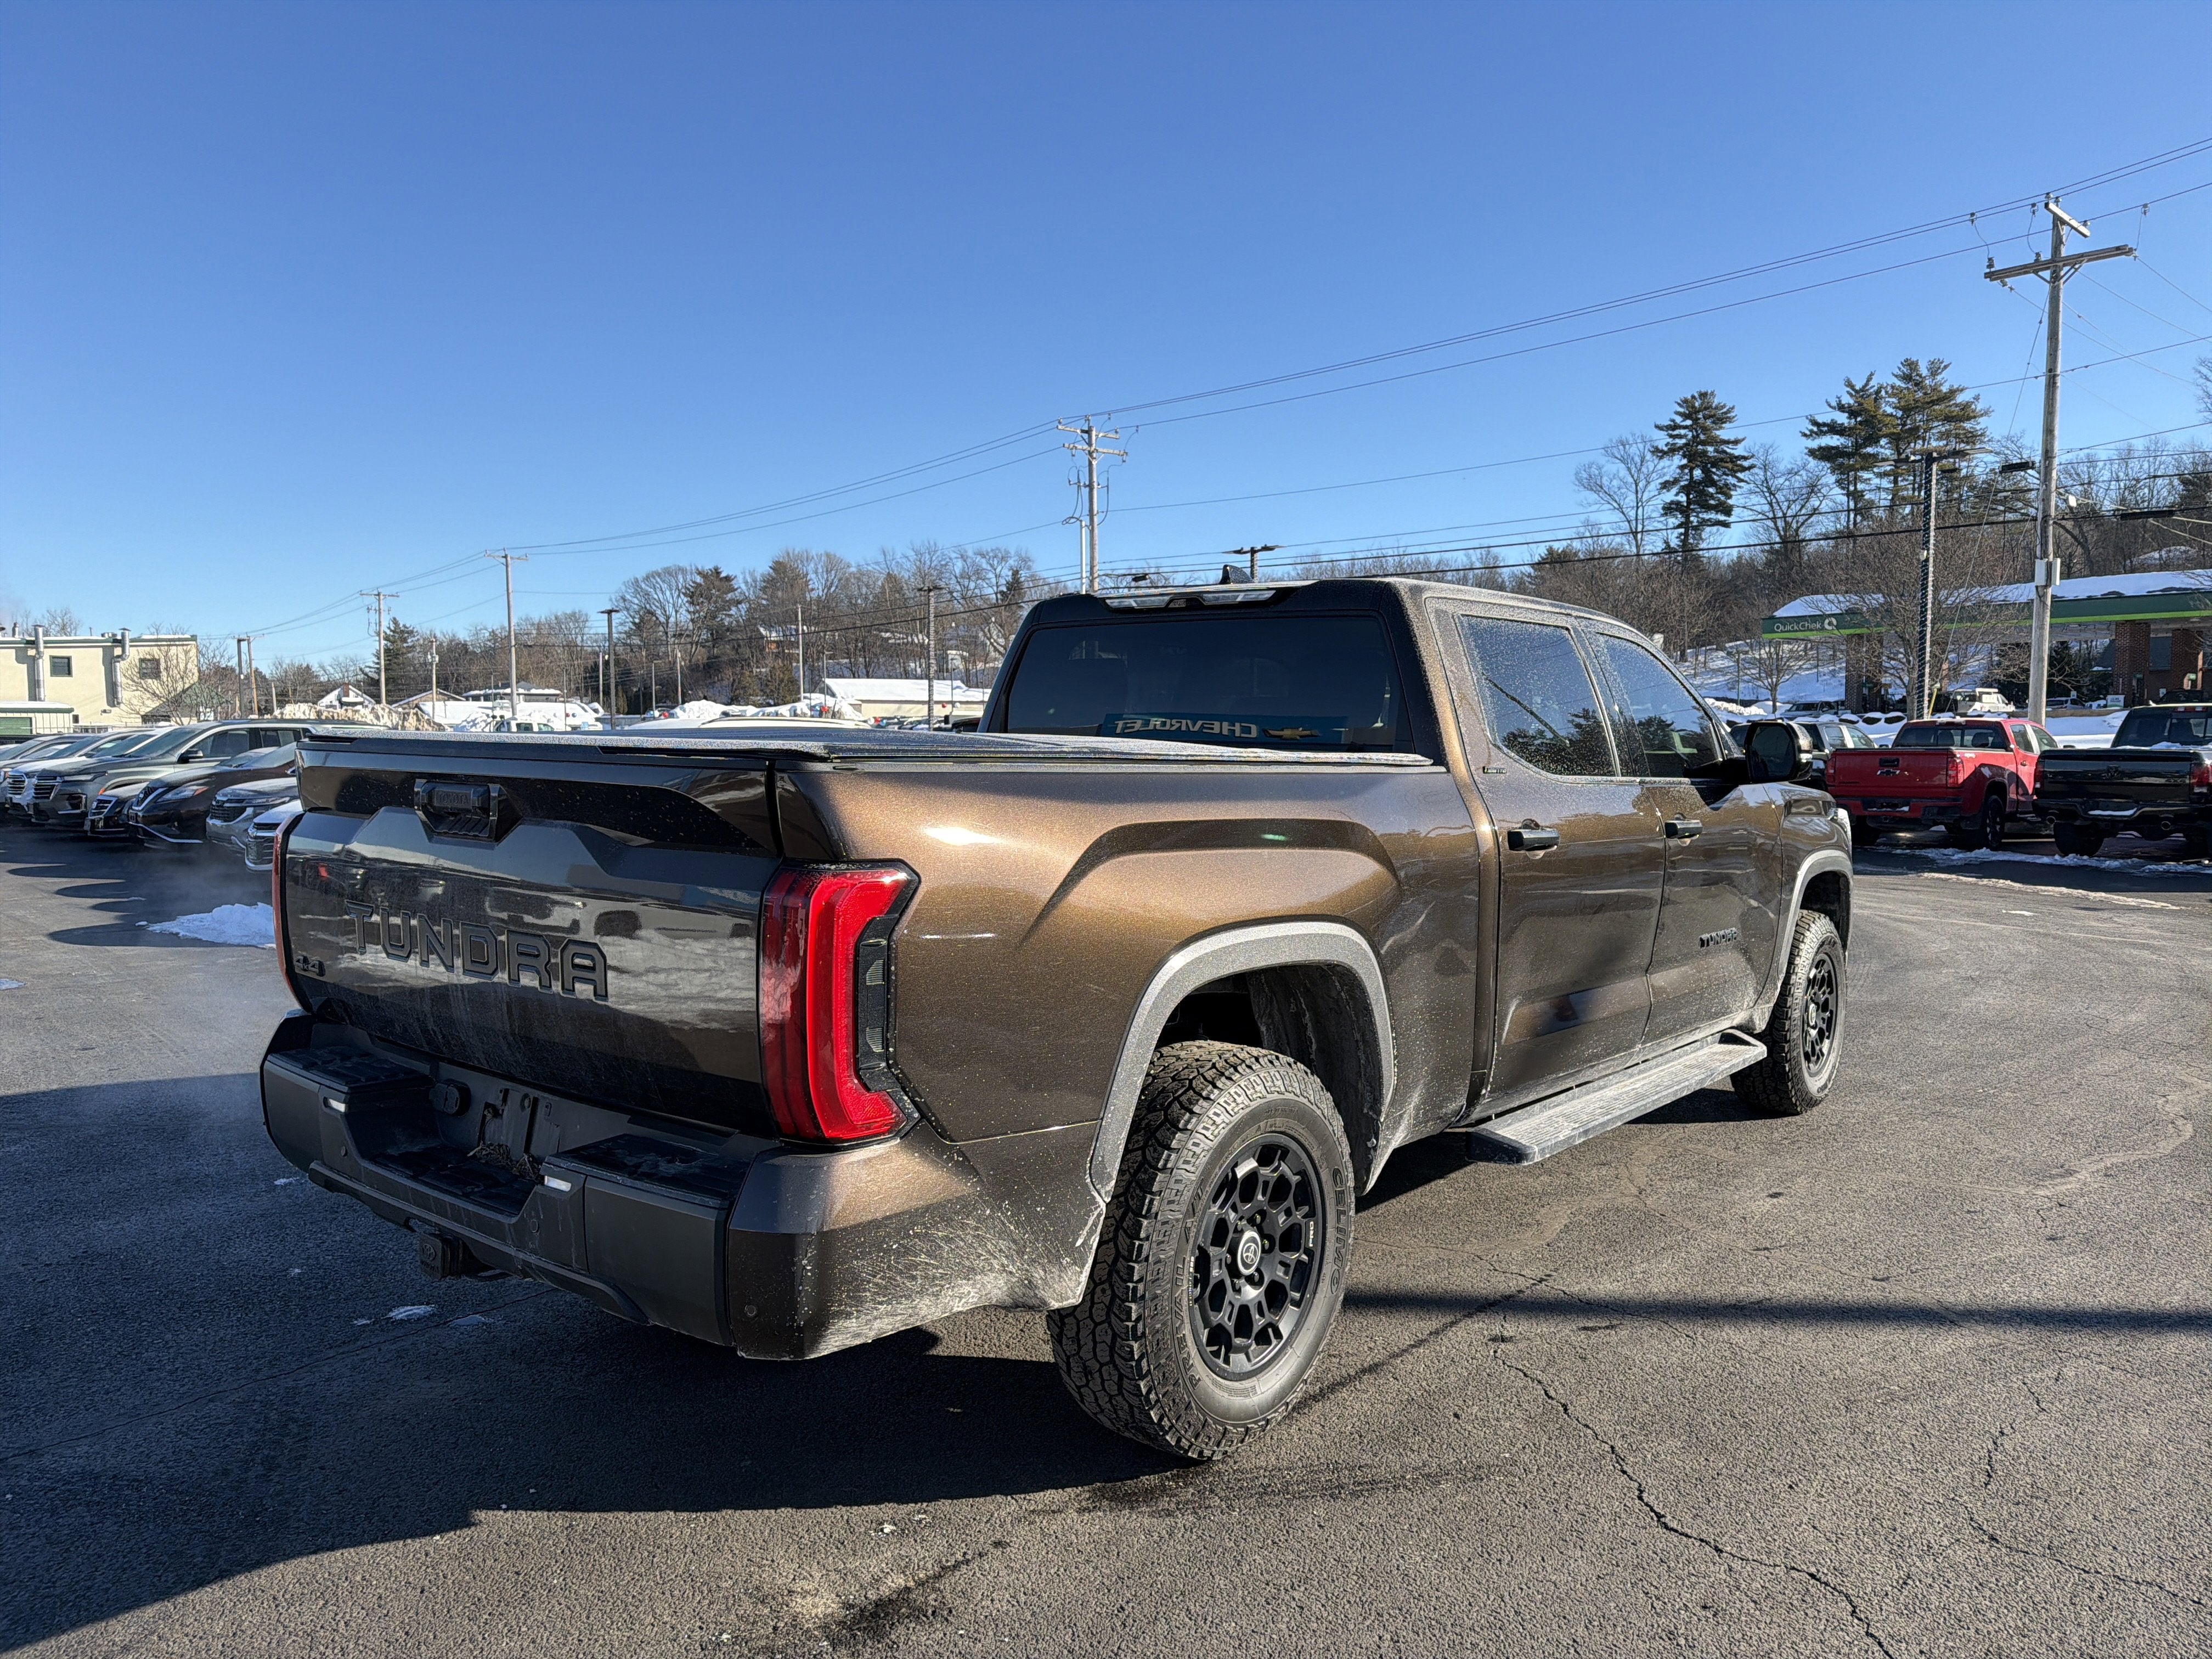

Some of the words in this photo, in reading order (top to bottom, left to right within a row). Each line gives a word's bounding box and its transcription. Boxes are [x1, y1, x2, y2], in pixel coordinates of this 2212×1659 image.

[1774, 620, 1822, 632] QuickChek
[438, 793, 469, 805] TOYOTA
[1699, 928, 1737, 949] TUNDRA
[345, 900, 609, 1002] TUNDRA
[1330, 1166, 1346, 1295] CELIMO
